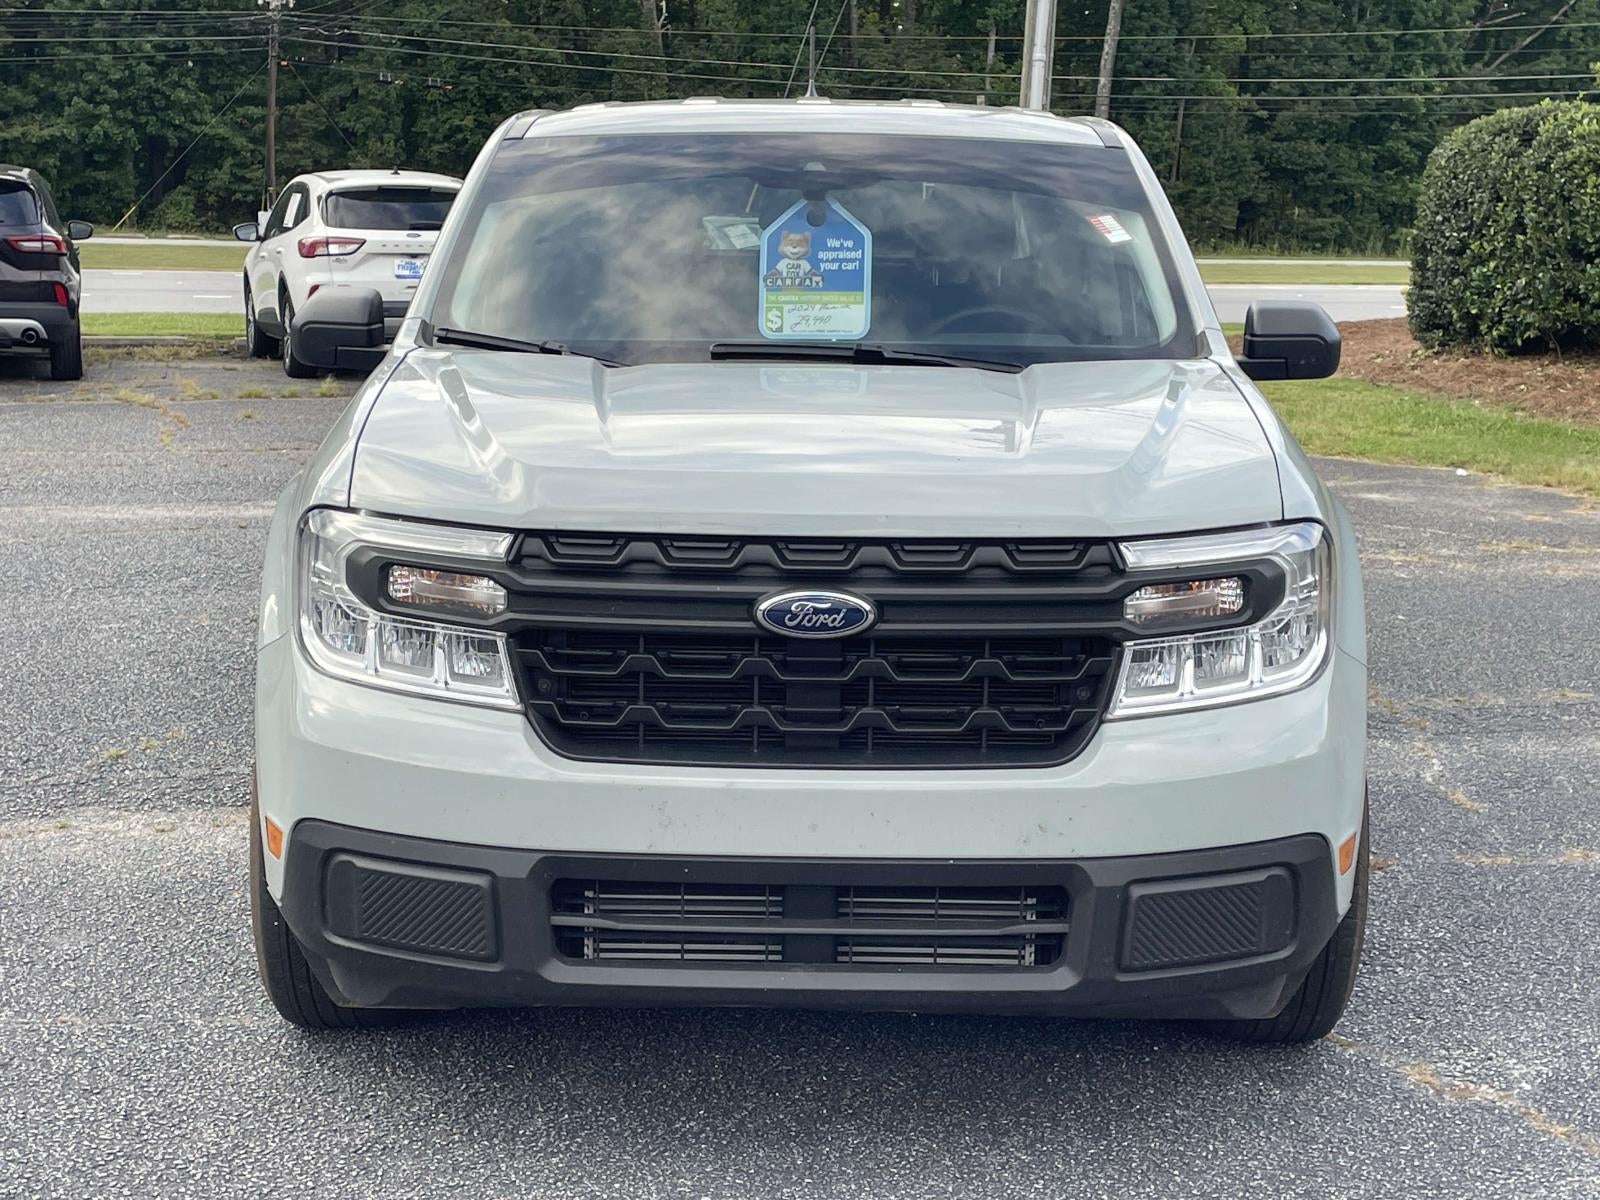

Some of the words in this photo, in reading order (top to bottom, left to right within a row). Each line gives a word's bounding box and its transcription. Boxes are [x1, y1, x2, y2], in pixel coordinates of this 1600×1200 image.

[826, 238, 853, 248] We've
[818, 249, 862, 261] appraised
[820, 262, 840, 272] your
[765, 277, 823, 288] CARFAX
[785, 601, 847, 627] Ford
